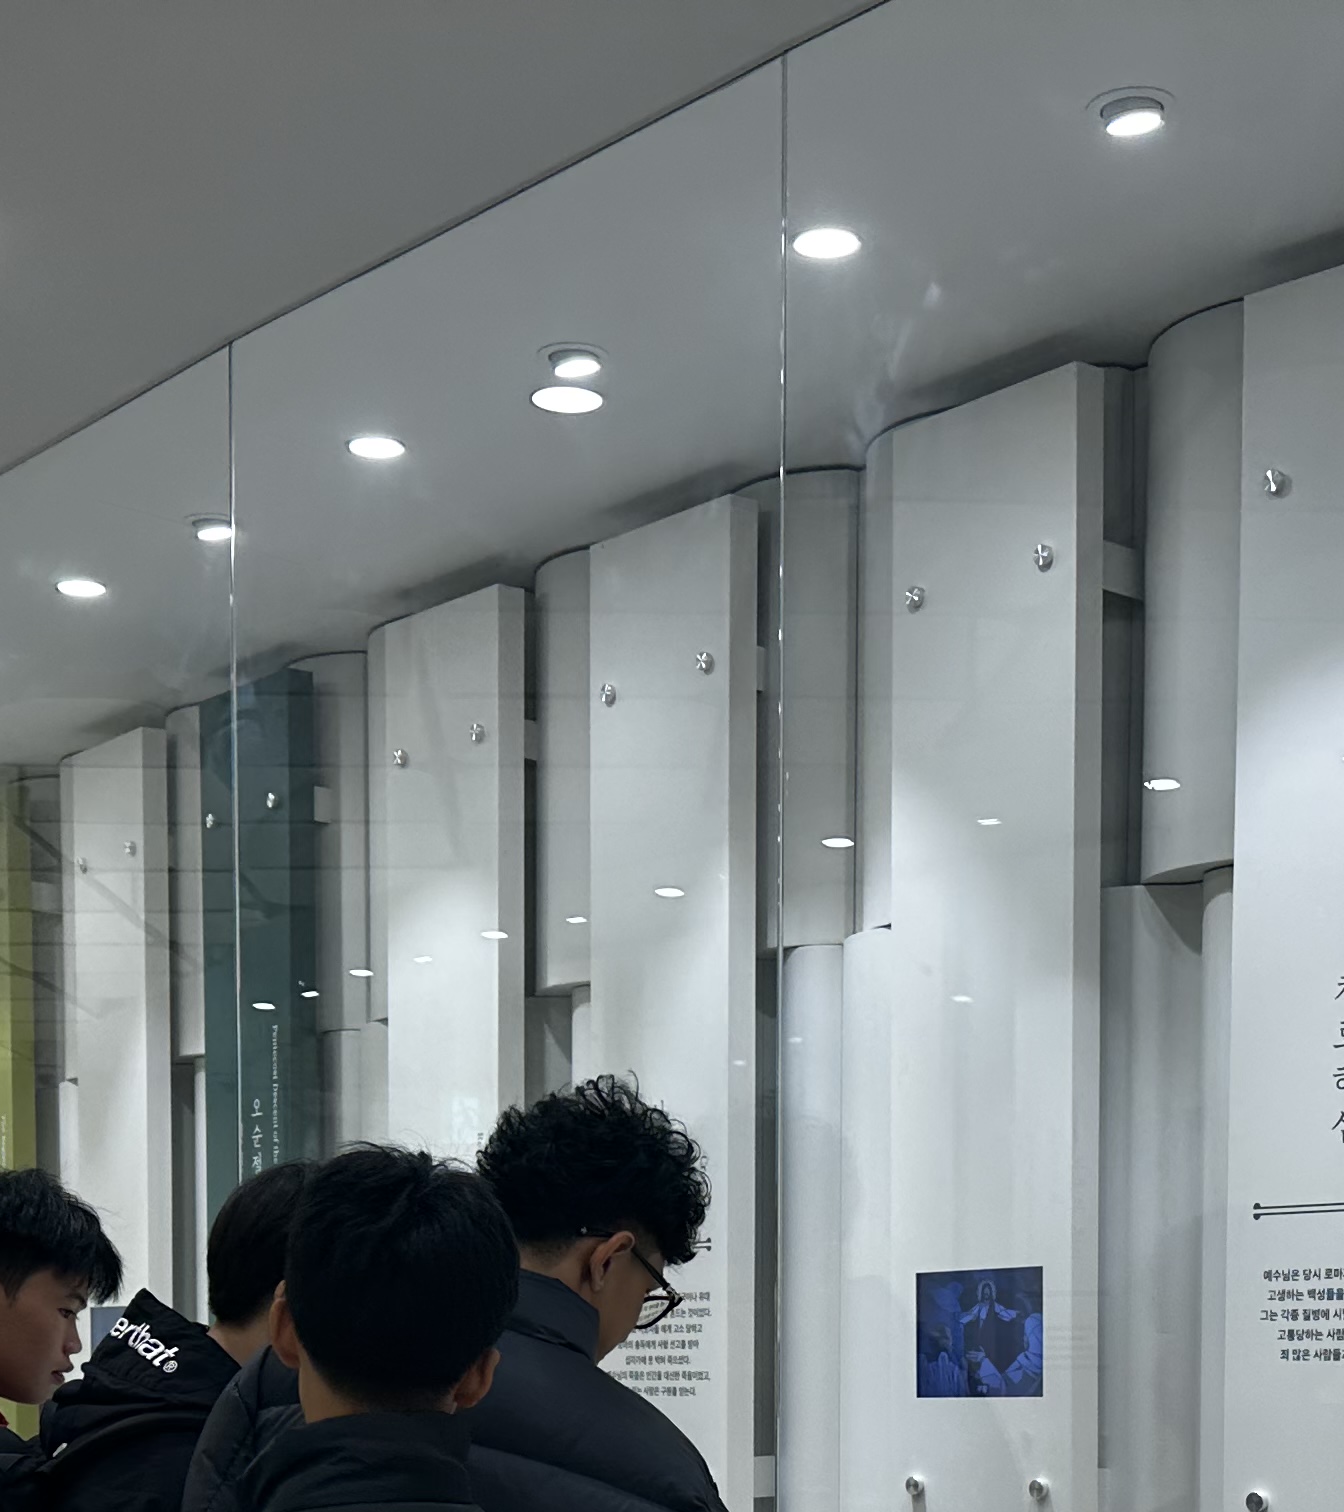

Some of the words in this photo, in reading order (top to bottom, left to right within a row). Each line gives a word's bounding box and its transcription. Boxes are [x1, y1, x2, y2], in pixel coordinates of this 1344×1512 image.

[1263, 1270, 1300, 1281] 예수님은
[1303, 1269, 1321, 1280] 당시
[1267, 1289, 1304, 1301] 고생하는
[1307, 1288, 1344, 1300] 백성들을
[1260, 1310, 1278, 1321] 그는
[1292, 1349, 1310, 1361] 많은
